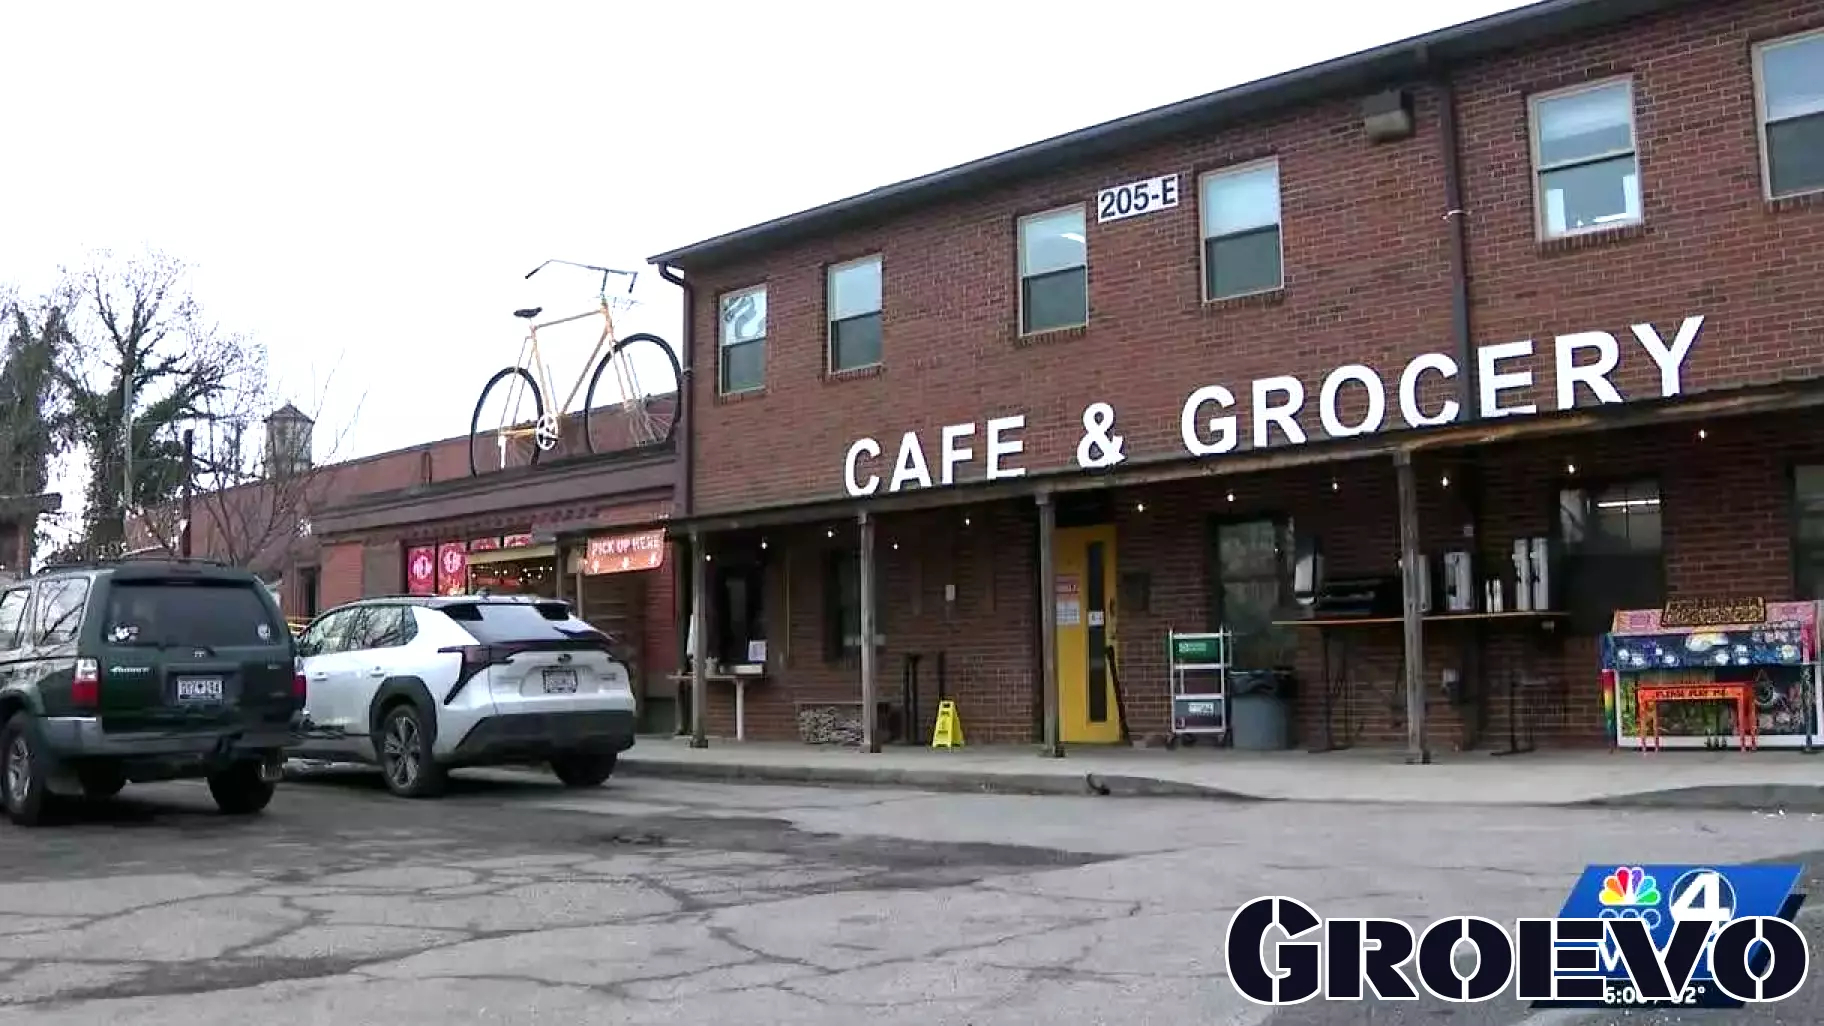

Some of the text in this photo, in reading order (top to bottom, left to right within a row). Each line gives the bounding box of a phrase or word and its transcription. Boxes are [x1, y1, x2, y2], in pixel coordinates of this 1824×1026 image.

[1101, 177, 1176, 219] 205-E
[845, 314, 1705, 496] CAFE & GROCERY
